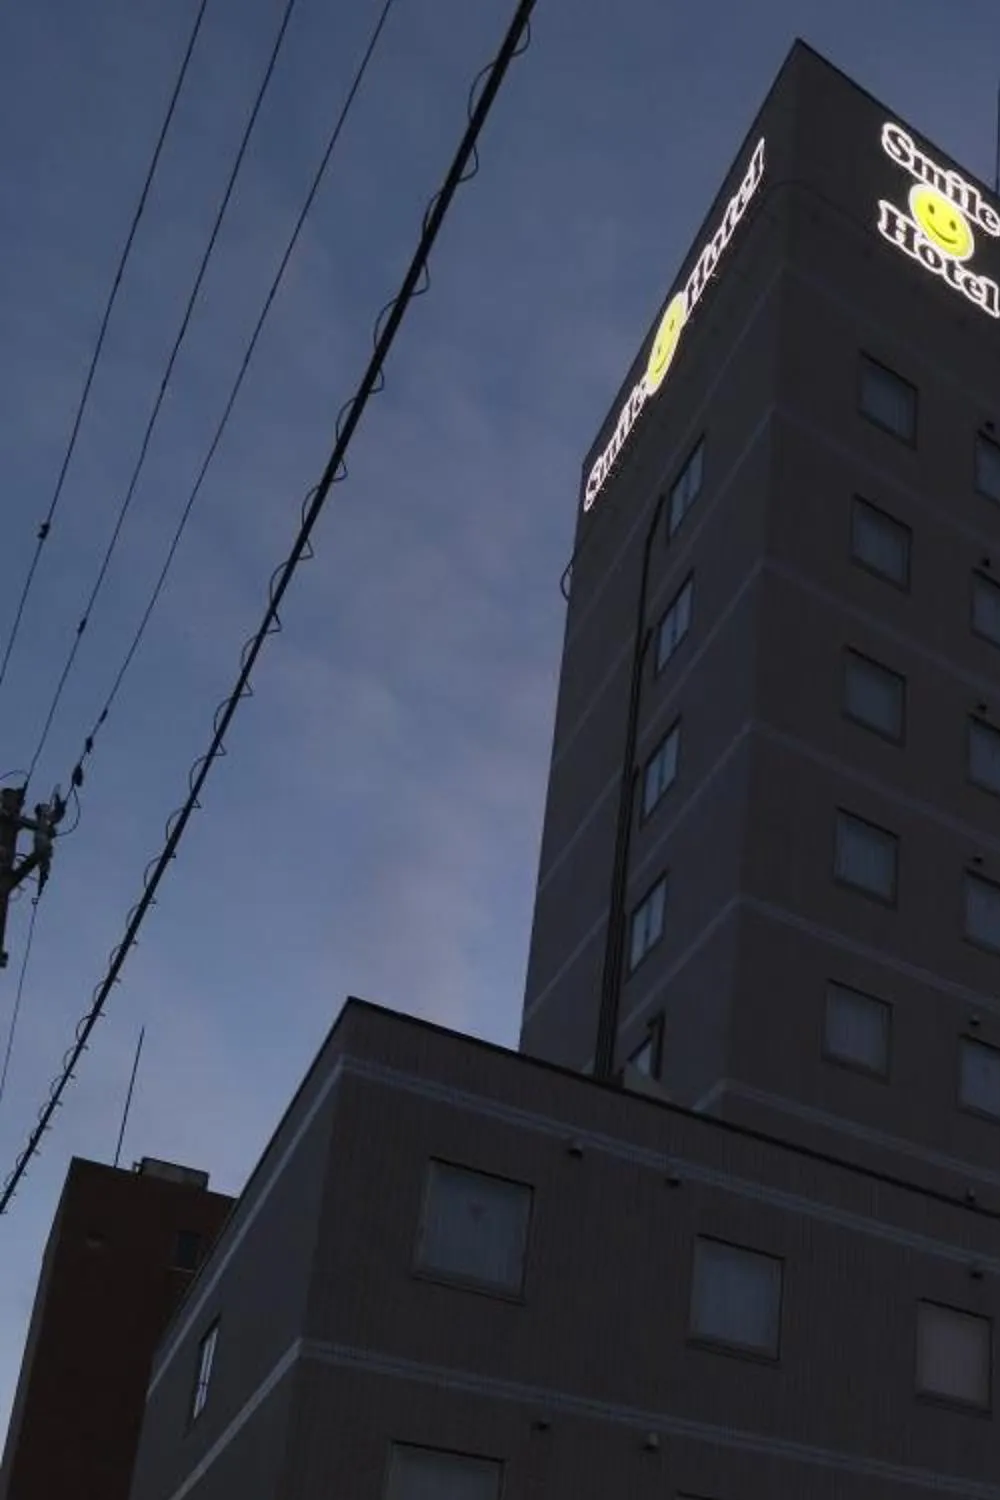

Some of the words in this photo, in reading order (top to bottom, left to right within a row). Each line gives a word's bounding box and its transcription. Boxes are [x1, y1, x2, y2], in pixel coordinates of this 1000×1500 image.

[583, 371, 649, 512] Smile
[684, 136, 765, 321] Hotel
[877, 199, 1000, 318] Hotel
